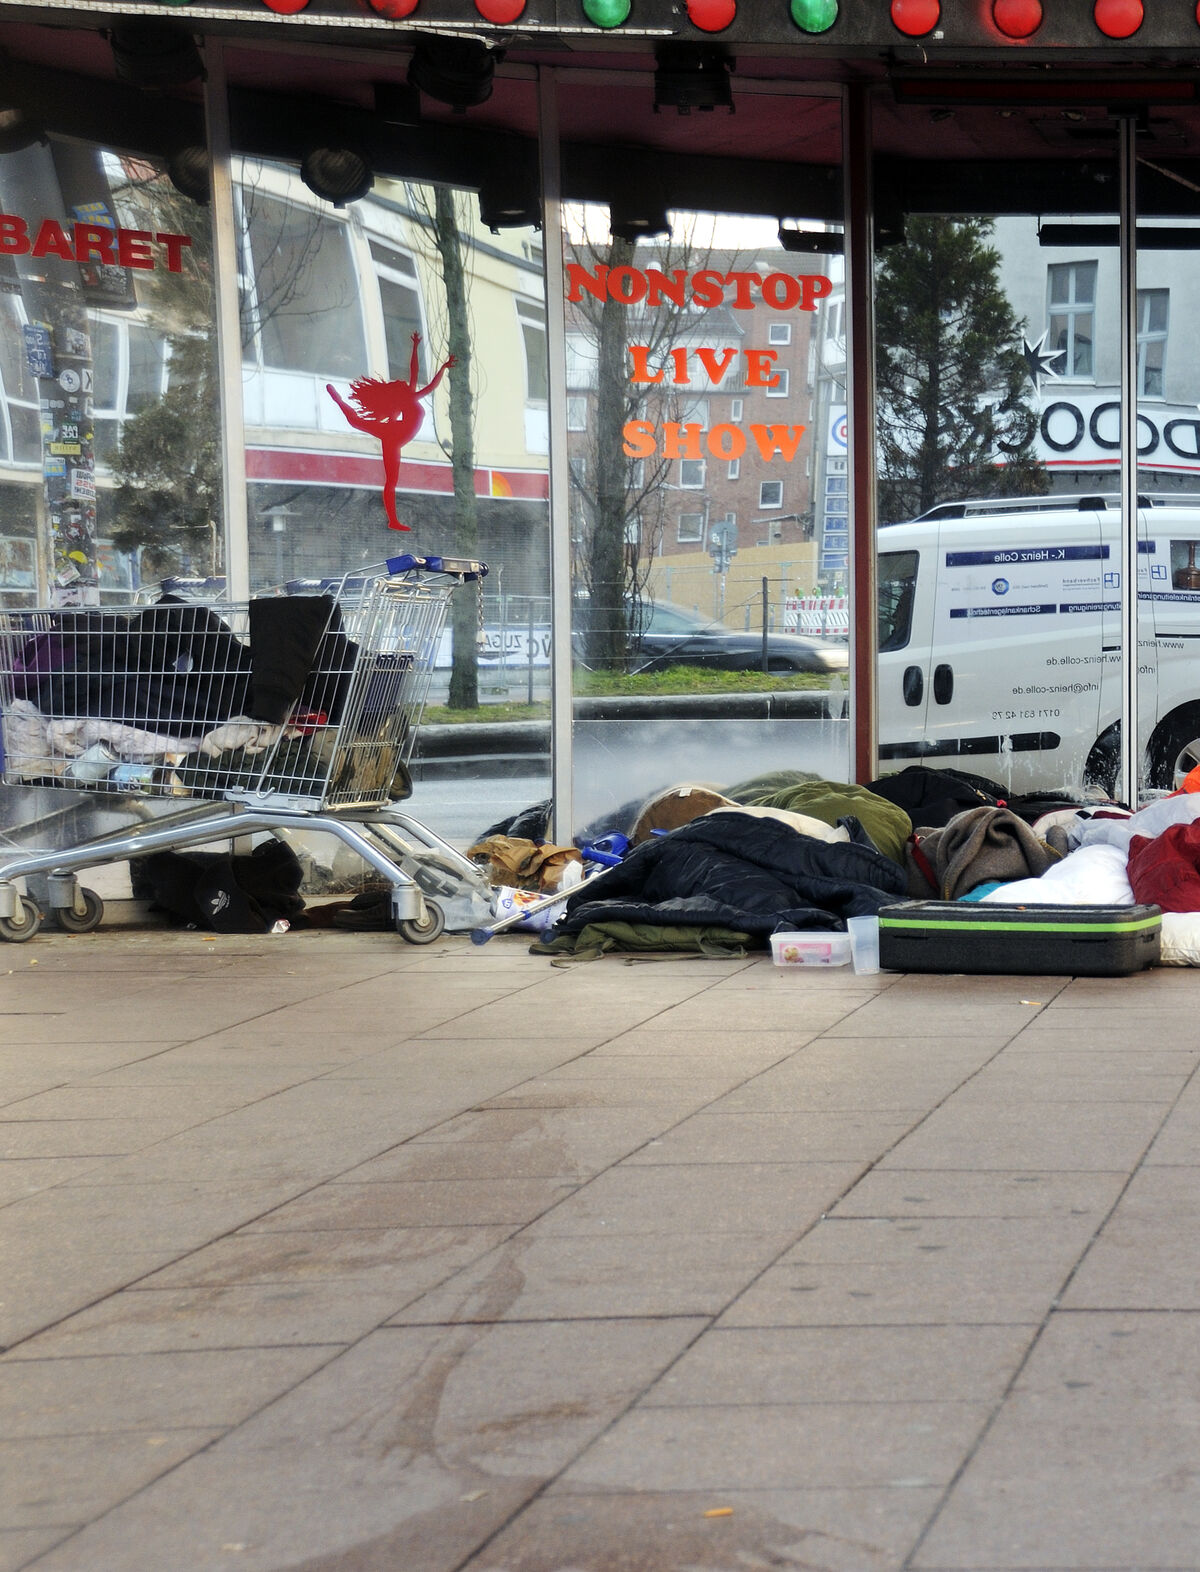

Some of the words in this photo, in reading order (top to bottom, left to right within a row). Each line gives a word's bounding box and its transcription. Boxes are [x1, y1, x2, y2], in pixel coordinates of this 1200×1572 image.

[0, 213, 193, 274] BARET
[566, 263, 833, 312] NONSTOP
[622, 420, 805, 462] SHOW
